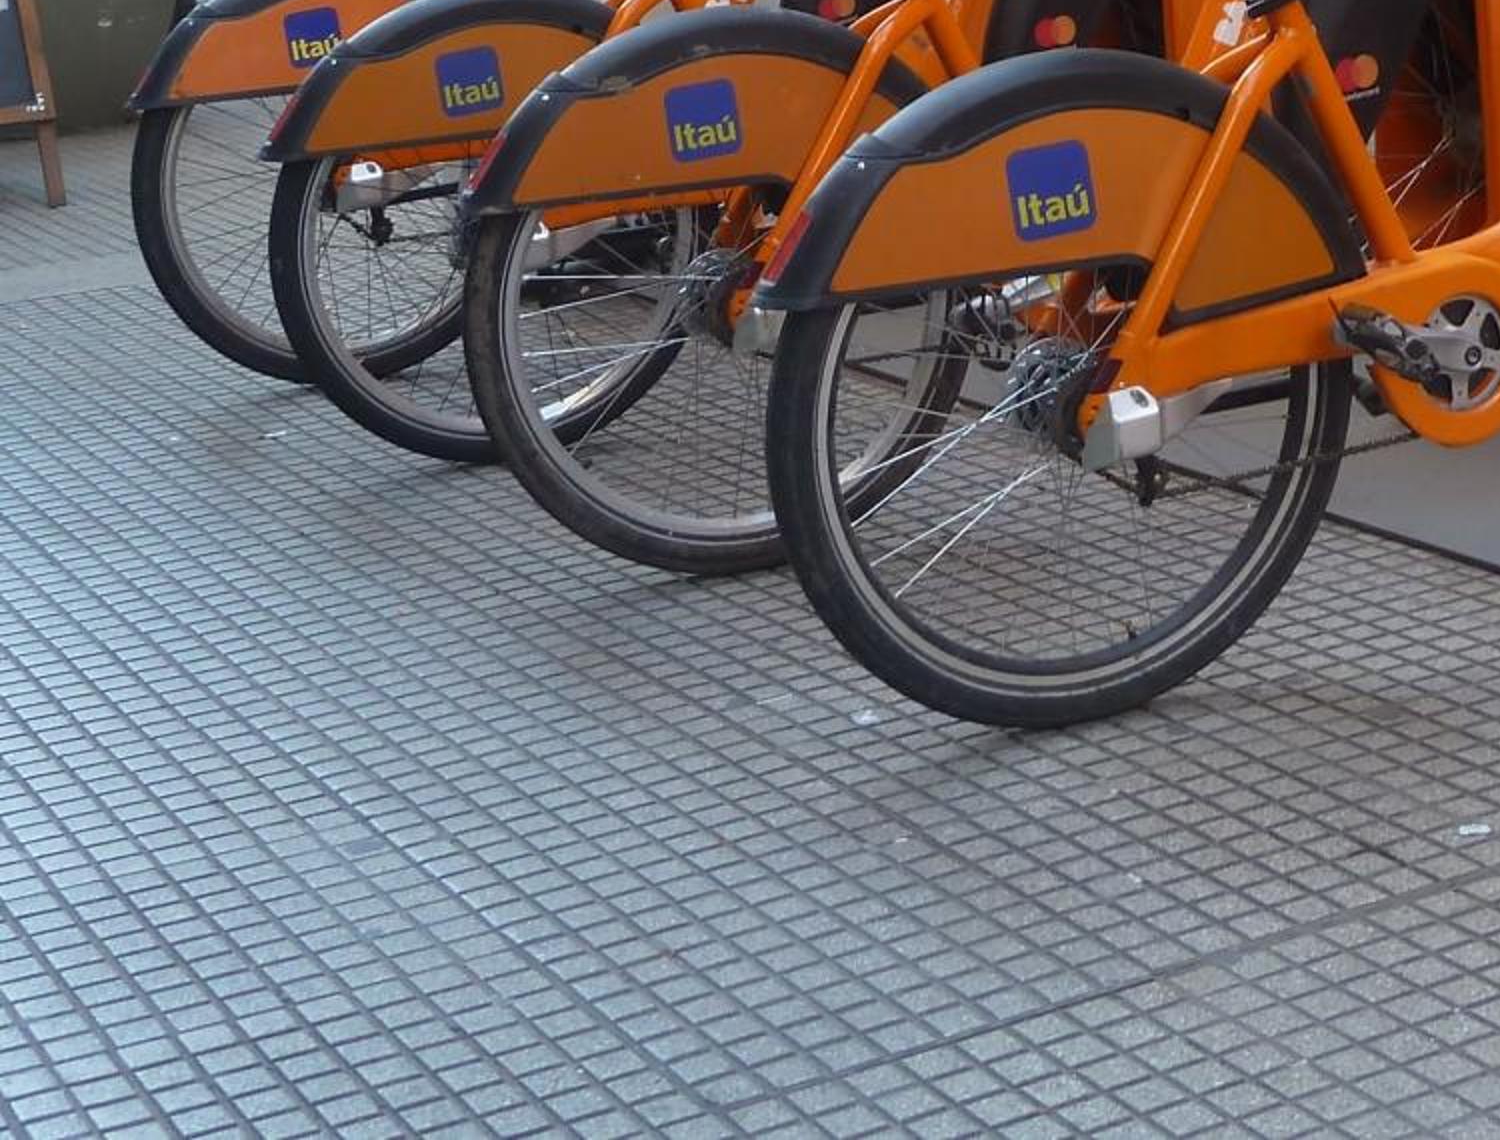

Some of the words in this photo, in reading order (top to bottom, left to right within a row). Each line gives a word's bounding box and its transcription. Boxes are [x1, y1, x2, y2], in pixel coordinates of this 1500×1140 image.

[291, 32, 344, 62] Itaú
[444, 75, 501, 108] Itaú
[673, 113, 737, 153] Itaú
[1017, 182, 1090, 229] Itaú
